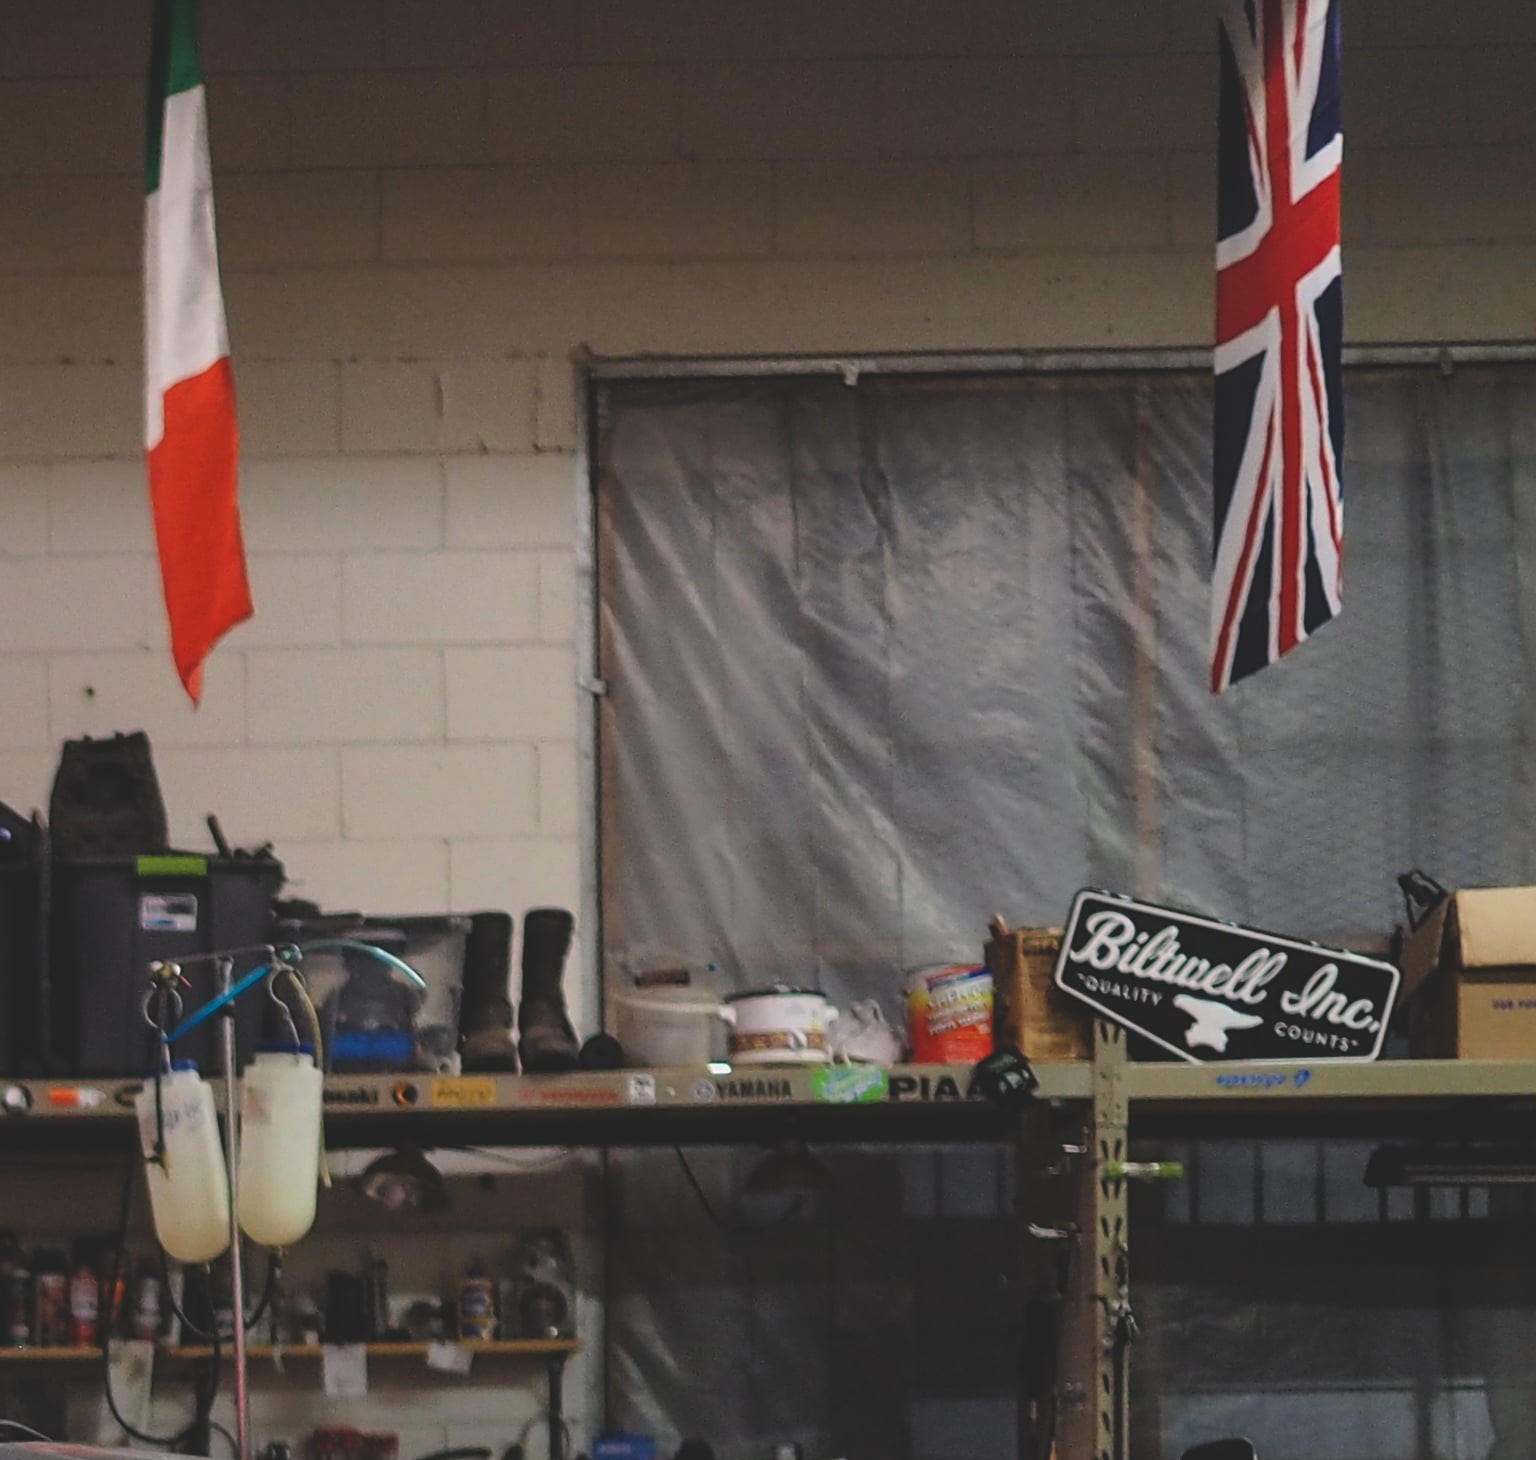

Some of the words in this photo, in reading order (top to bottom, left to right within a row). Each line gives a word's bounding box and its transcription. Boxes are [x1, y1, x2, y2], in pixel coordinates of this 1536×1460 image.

[1069, 910, 1288, 1004] Biltwell
[1280, 963, 1381, 1033] Inc.
[716, 1079, 792, 1098] YAMAHA
